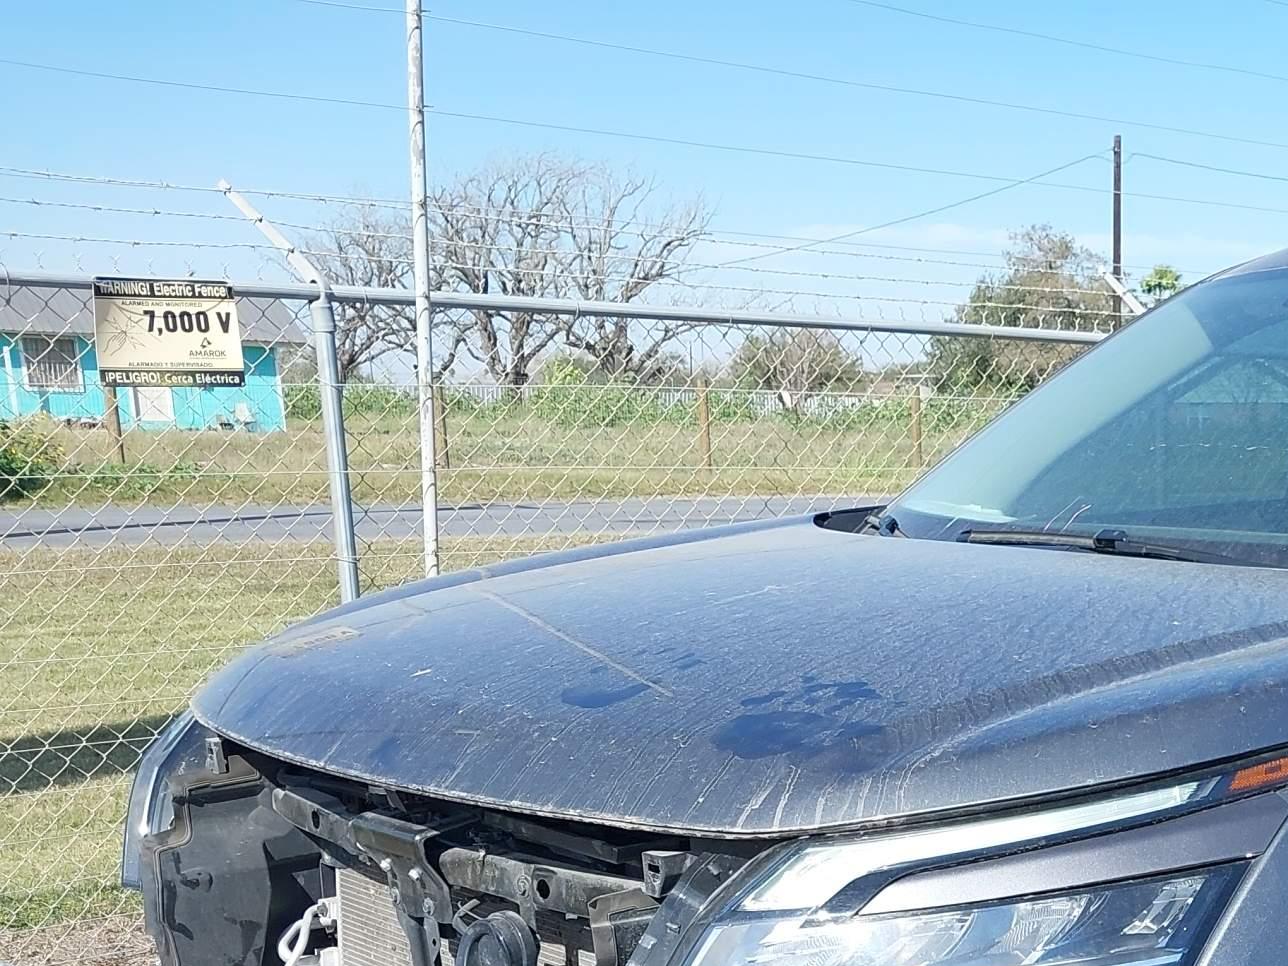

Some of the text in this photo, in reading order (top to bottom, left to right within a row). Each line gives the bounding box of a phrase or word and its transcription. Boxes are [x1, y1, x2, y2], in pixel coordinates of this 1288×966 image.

[153, 282, 193, 297] Electric
[143, 310, 231, 337] 7,000 V
[164, 373, 193, 384] Cerca
[195, 373, 240, 384] Eléctrica
